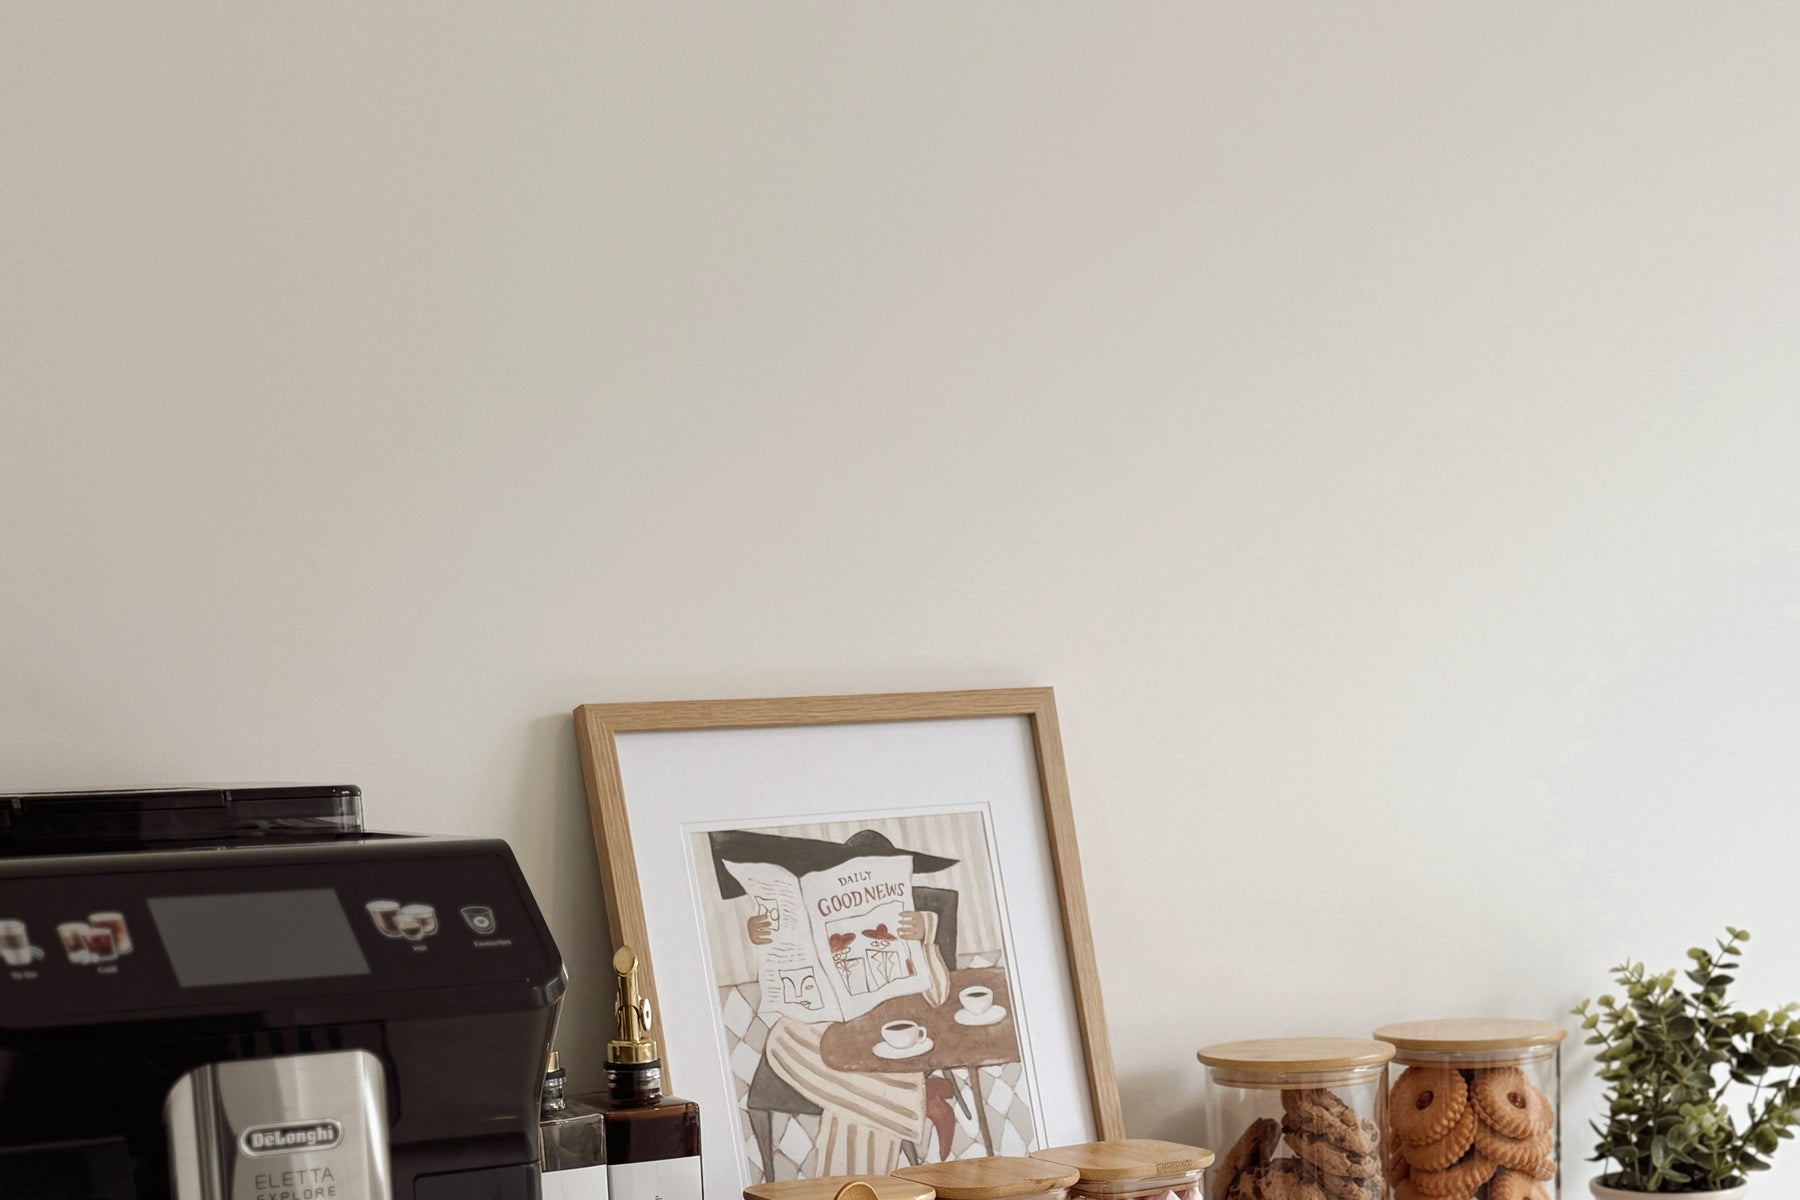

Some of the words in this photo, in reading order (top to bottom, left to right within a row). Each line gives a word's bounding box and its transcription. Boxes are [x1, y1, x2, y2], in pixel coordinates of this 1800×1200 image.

[838, 871, 872, 887] DAILY
[817, 890, 863, 917] GOOD
[864, 882, 905, 904] NEWS
[255, 1167, 335, 1191] ELETTA
